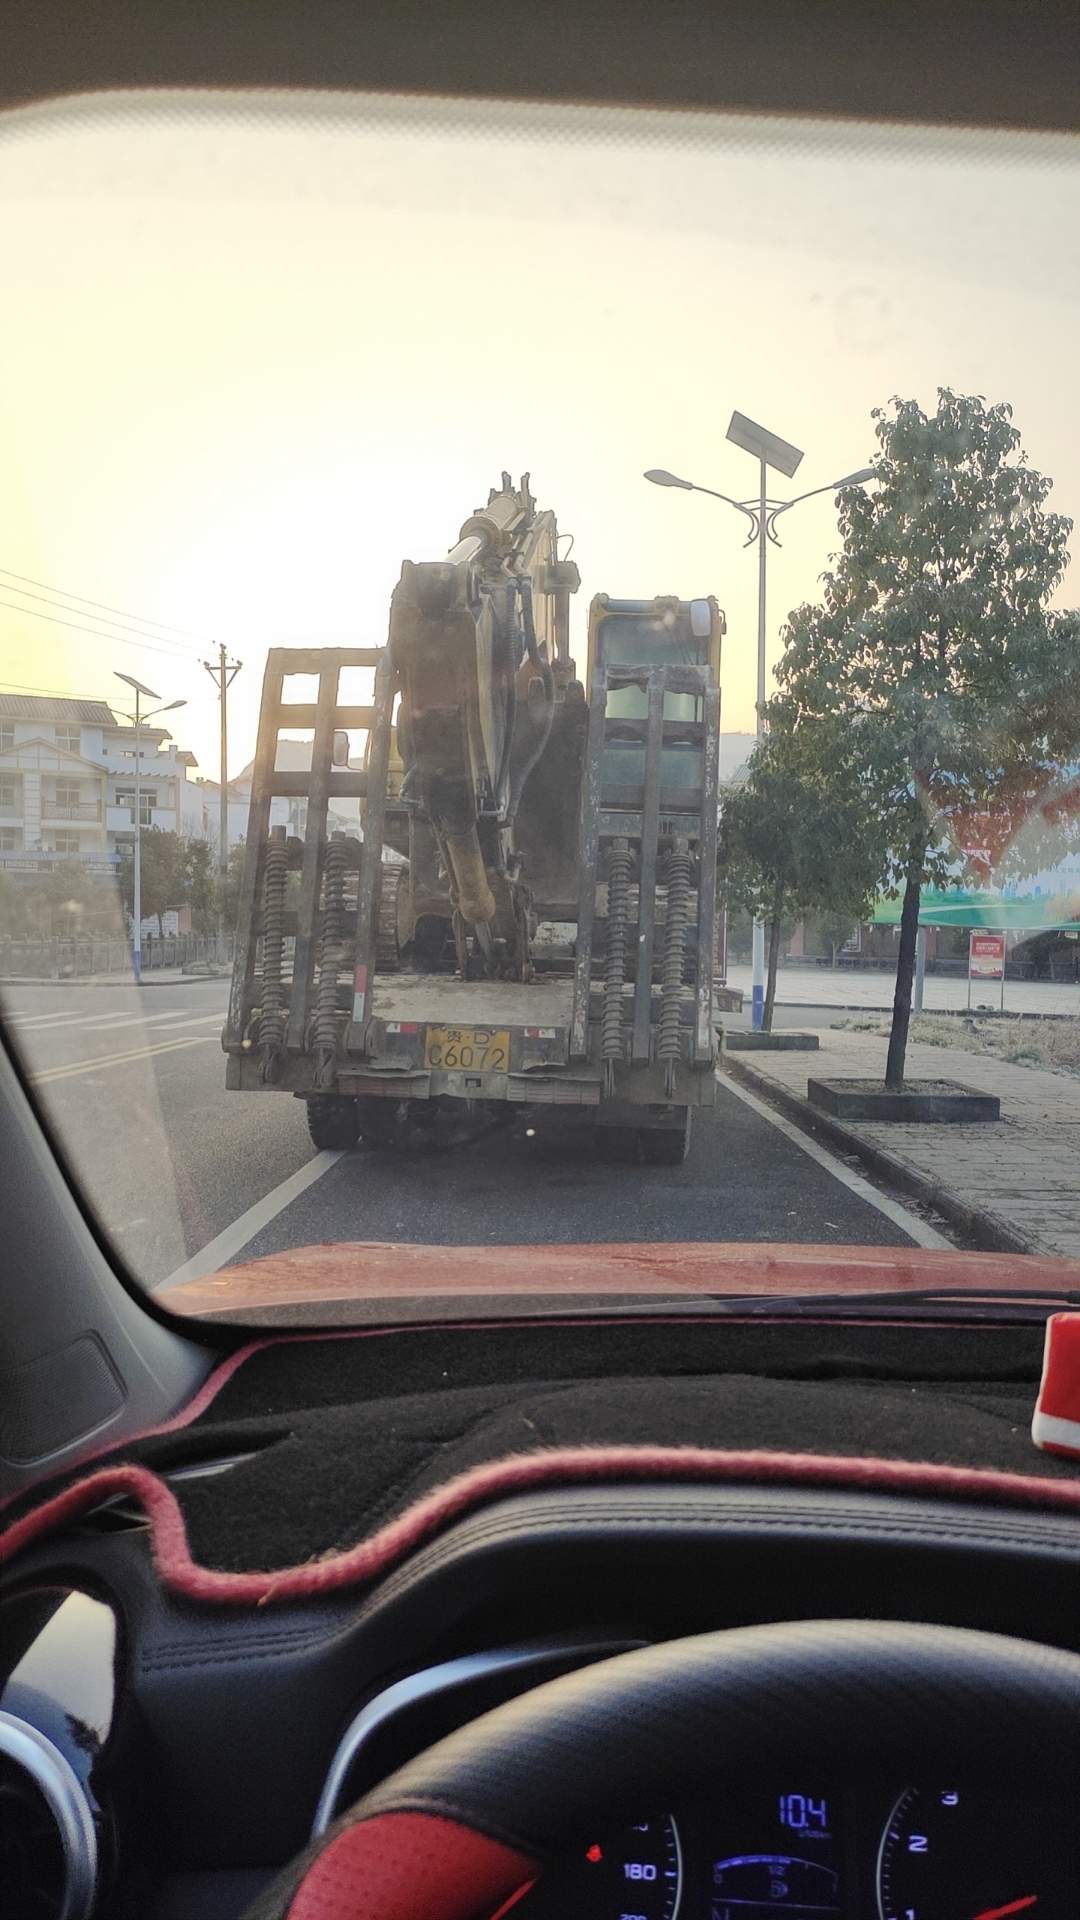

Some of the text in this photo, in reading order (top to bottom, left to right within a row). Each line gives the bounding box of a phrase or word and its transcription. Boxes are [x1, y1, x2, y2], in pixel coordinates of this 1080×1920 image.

[429, 1044, 505, 1070] C6072
[908, 1835, 928, 1851] 2
[624, 1863, 656, 1880] 180
